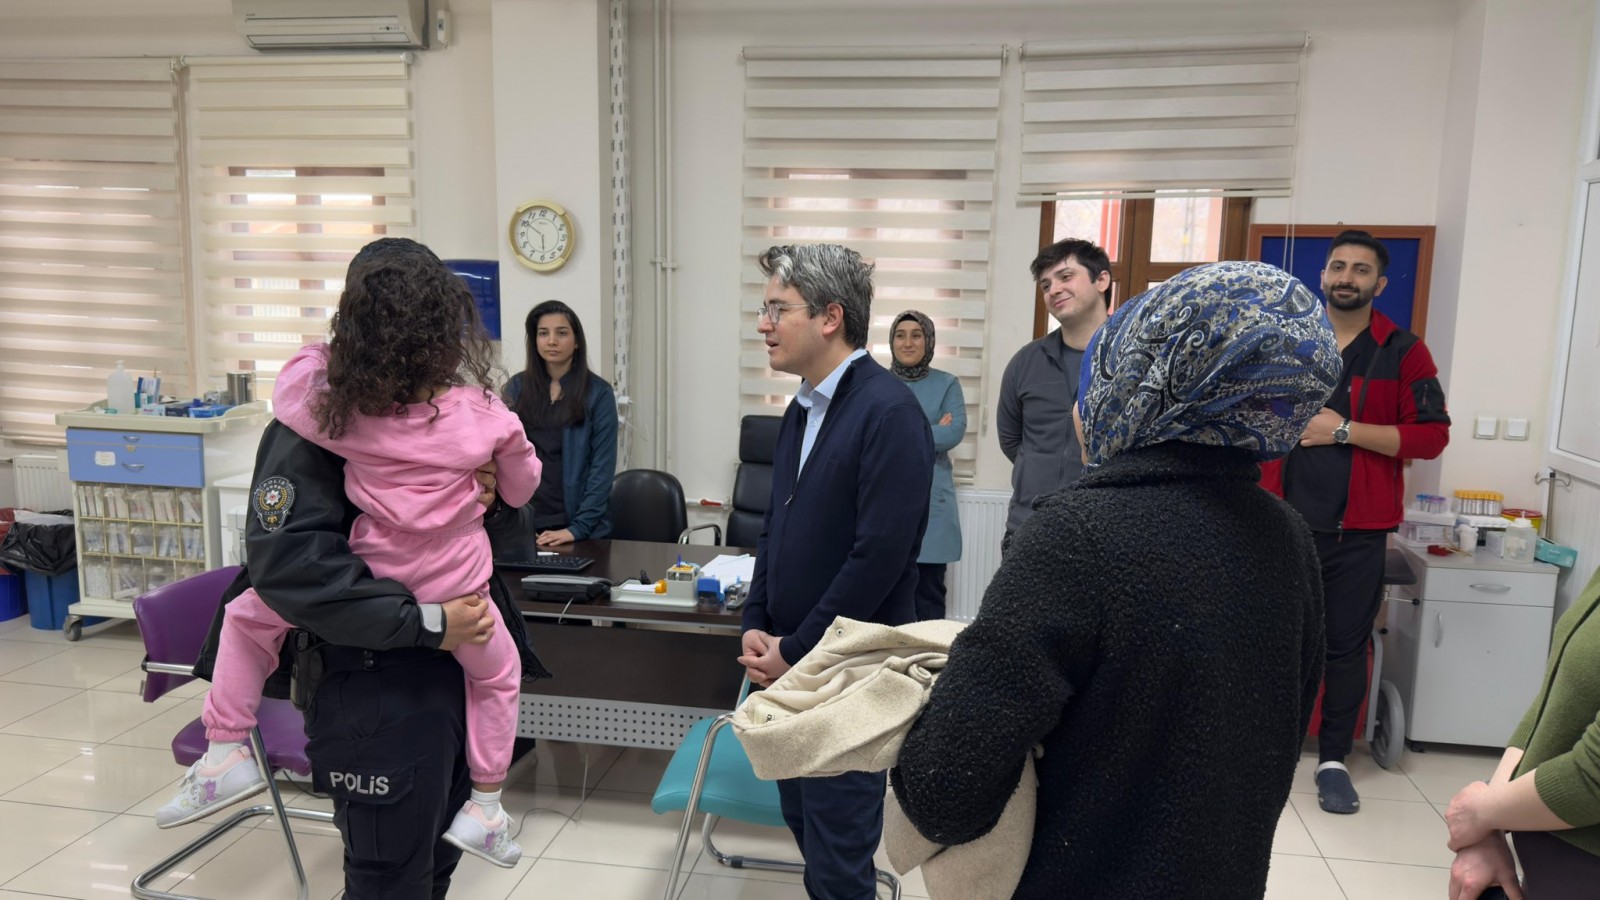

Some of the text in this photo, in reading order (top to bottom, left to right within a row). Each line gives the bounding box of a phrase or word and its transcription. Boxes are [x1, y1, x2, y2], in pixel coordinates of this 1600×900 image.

[528, 212, 536, 220] 11
[539, 209, 548, 218] 12
[559, 223, 565, 231] 2
[530, 250, 536, 258] 7
